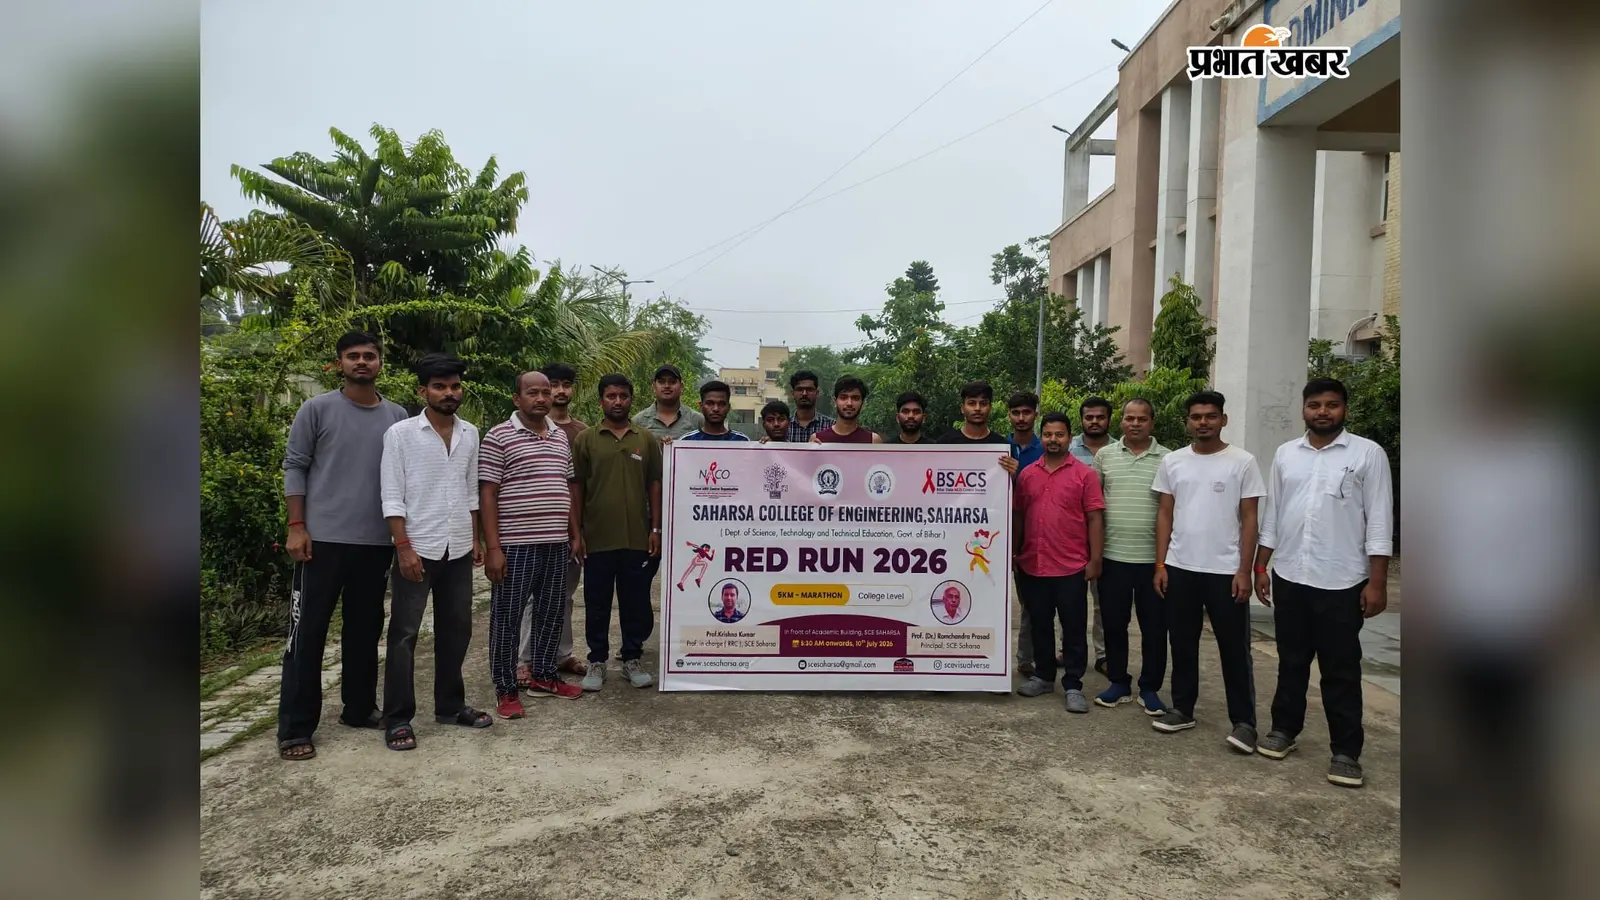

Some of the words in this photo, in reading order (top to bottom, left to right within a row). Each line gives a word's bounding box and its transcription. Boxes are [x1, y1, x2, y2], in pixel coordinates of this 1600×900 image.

[699, 462, 731, 485] NACO
[937, 472, 987, 487] BSACS
[693, 504, 754, 521] SAHARSA
[758, 504, 814, 522] COLLEGE
[818, 506, 834, 522] OF
[743, 528, 751, 537] of
[752, 529, 778, 538] Science,
[780, 529, 815, 538] Technology
[817, 529, 830, 537] and
[831, 529, 860, 538] Technical
[862, 530, 894, 539] Education,
[916, 530, 923, 538] of
[924, 530, 941, 539] Bihar
[724, 547, 788, 573] RED
[798, 547, 864, 573] RUN
[873, 547, 948, 574] 2026
[777, 591, 794, 599] 5KM
[858, 592, 885, 602] College
[739, 630, 756, 638] Kumar
[840, 629, 863, 637] Building,
[911, 632, 924, 640] Prof.
[937, 632, 970, 640] Ramchandra
[705, 640, 723, 648] charge
[825, 640, 854, 648] onwards,
[686, 660, 750, 669] www.scesaharsa.org
[807, 661, 877, 670] scesaharsa@gmail.com
[944, 661, 990, 669] scevisualverse
